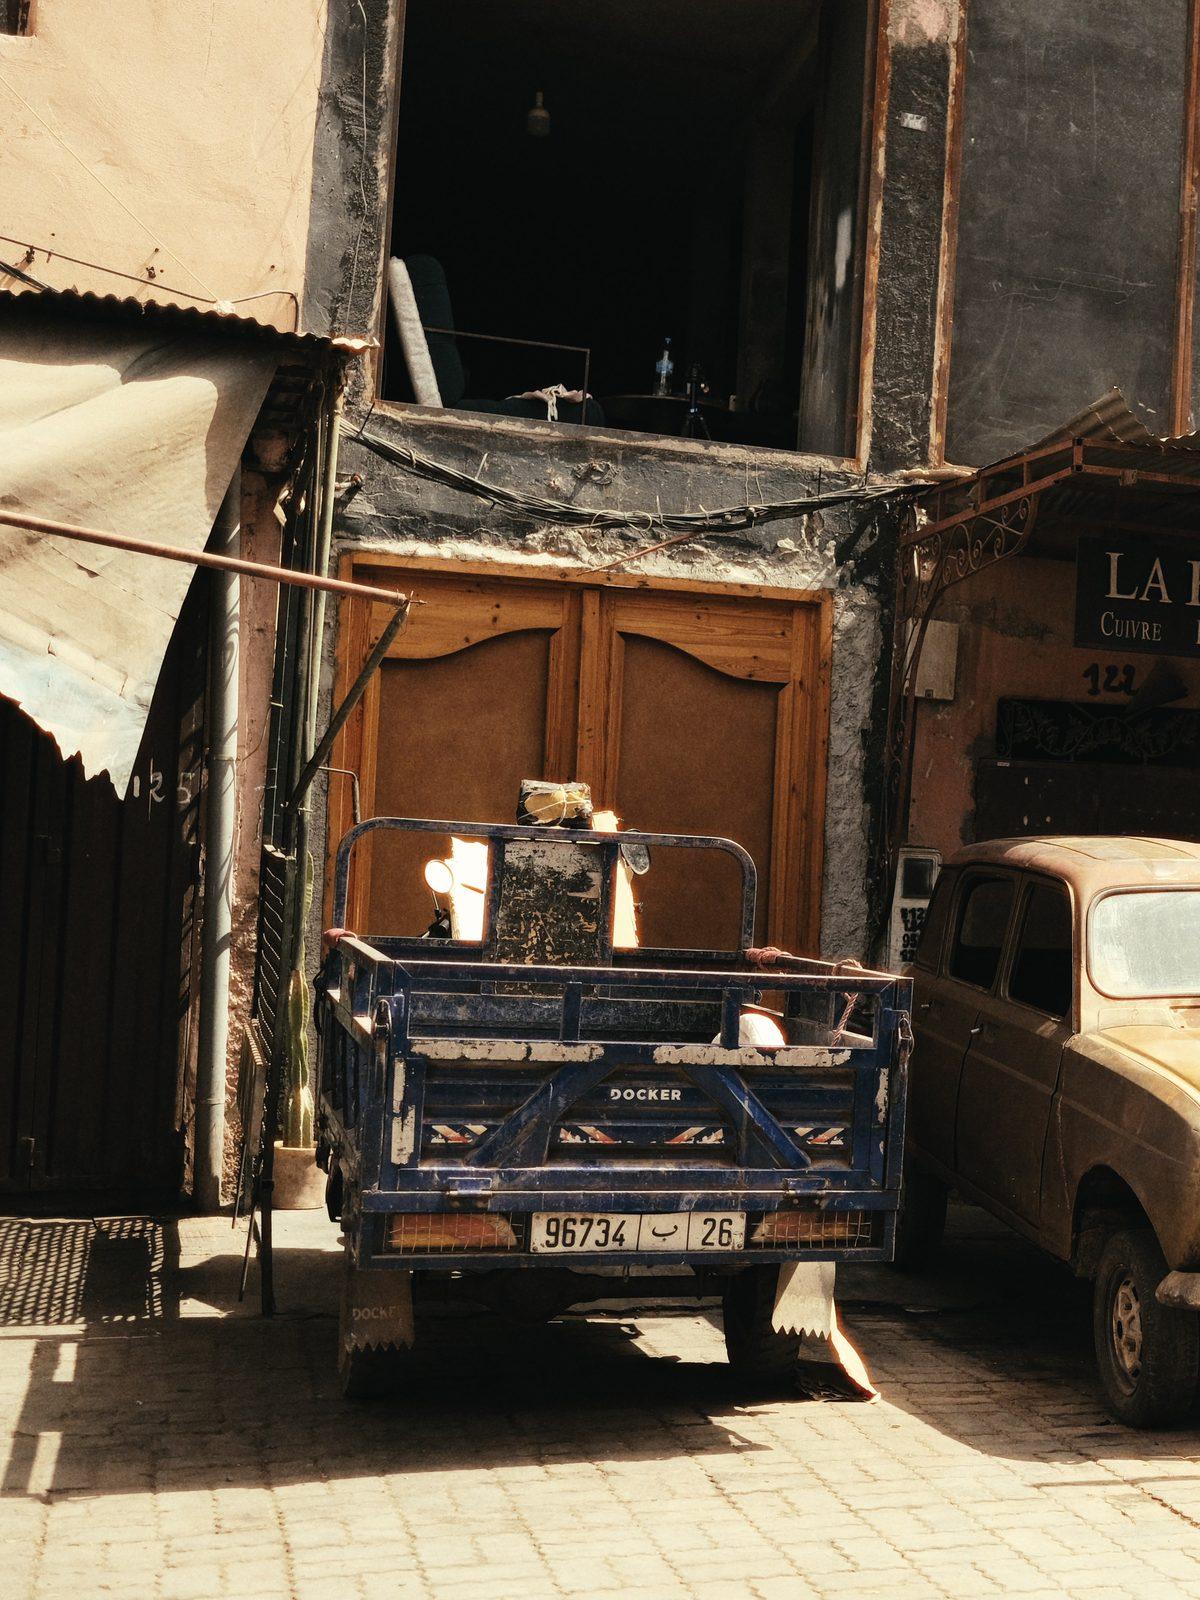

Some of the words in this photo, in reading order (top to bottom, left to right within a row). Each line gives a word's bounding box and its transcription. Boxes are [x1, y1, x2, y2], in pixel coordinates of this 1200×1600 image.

[1104, 551, 1174, 604] LA
[1100, 610, 1163, 642] CUIVRE
[610, 1088, 682, 1101] DOCKER
[545, 1217, 626, 1248] 96734
[651, 1224, 679, 1242] ب
[701, 1217, 734, 1247] 26
